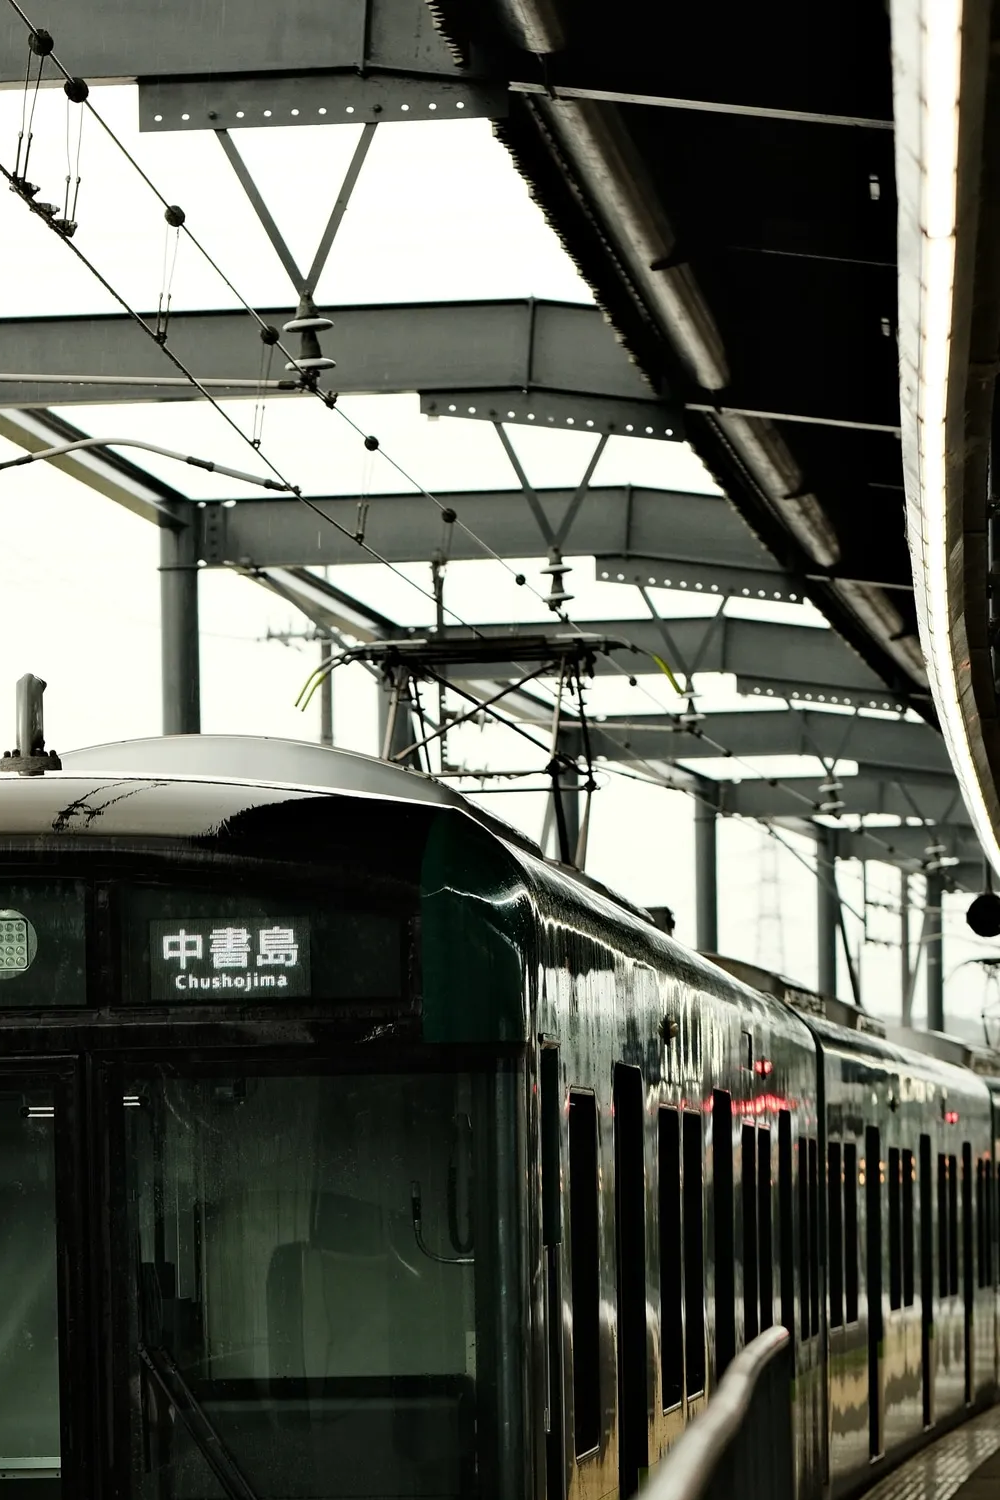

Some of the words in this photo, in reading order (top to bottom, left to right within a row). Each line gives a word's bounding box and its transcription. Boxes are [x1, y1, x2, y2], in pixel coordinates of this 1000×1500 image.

[162, 926, 299, 970] 中書島
[175, 972, 288, 992] Chushojima
